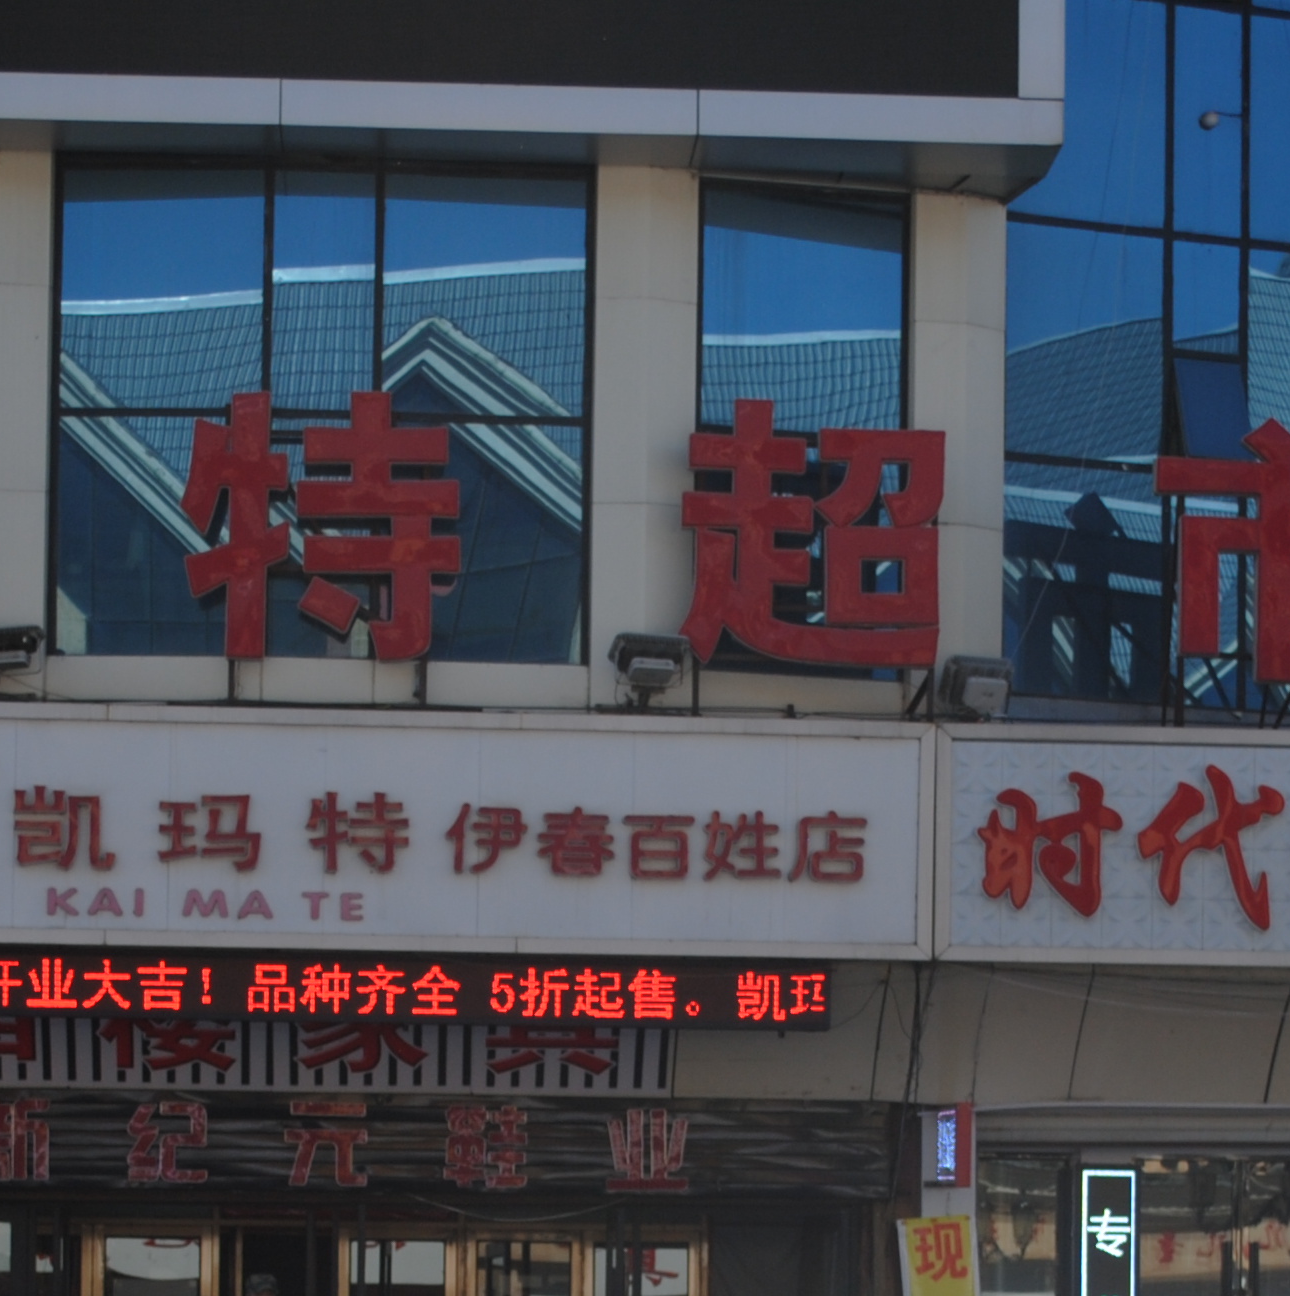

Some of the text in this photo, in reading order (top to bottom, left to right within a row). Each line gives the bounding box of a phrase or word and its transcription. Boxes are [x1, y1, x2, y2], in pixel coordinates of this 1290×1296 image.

[13, 785, 867, 883] 凯玛特伊春百姓店
[46, 886, 365, 922] KAI MA TE
[246, 963, 462, 1016] 品种齐全
